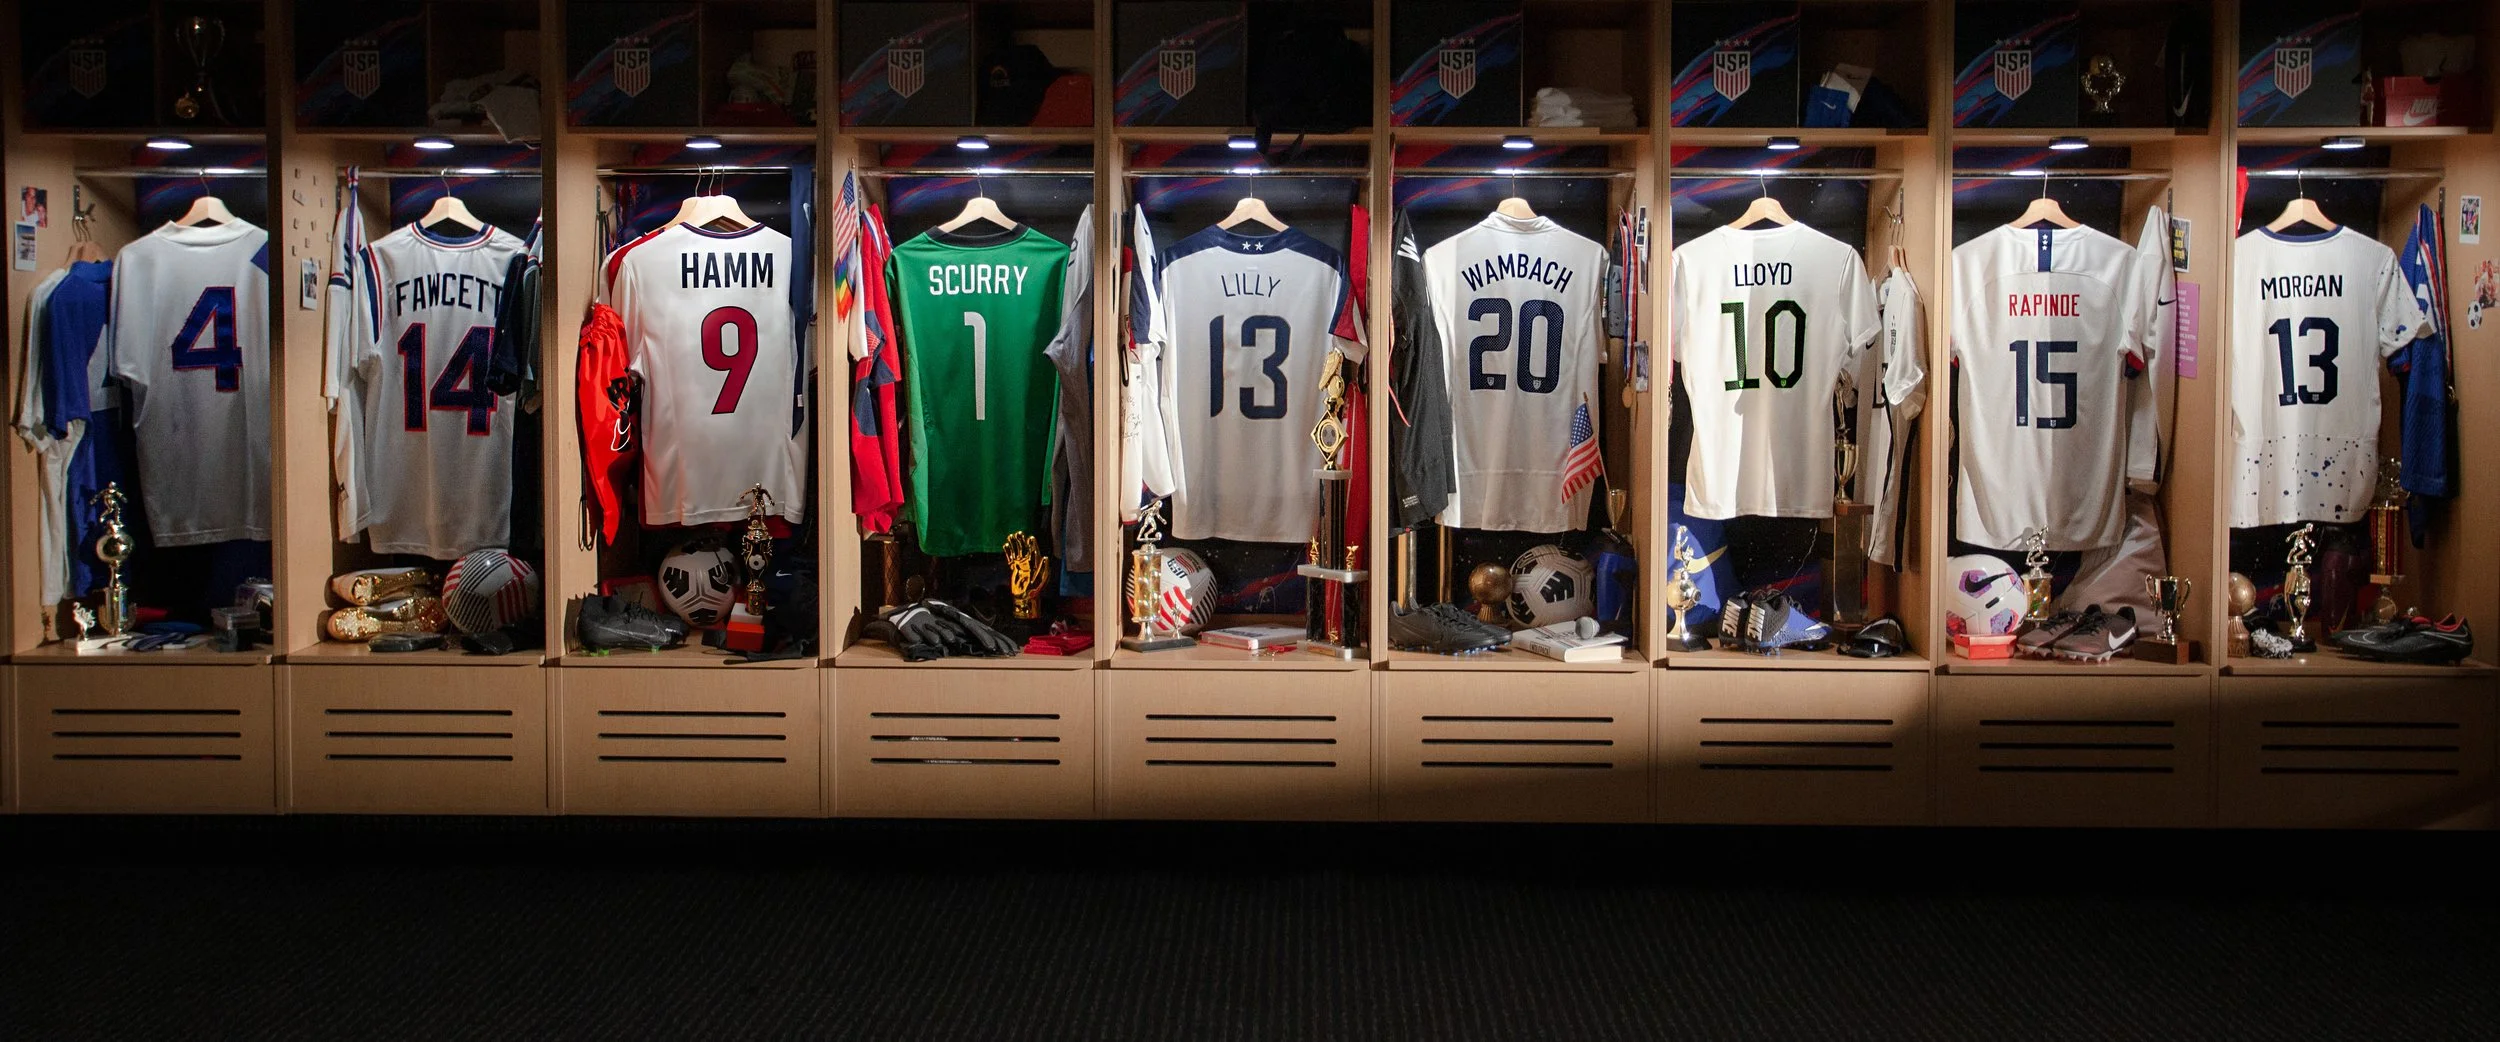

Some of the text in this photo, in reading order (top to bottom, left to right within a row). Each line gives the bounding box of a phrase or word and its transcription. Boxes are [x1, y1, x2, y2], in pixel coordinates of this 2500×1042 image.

[71, 52, 103, 69] USA
[346, 53, 377, 72] USA
[616, 51, 648, 69] USA
[890, 51, 922, 69] USA
[1162, 52, 1193, 70] USA
[1441, 52, 1473, 70] USA
[1716, 54, 1748, 72] USA
[1997, 53, 2029, 71] USA
[2277, 50, 2309, 69] USA
[681, 252, 774, 289] HAMM
[929, 264, 1028, 295] SCURRY
[1221, 273, 1281, 298] LILLY
[1461, 253, 1573, 293] WAMBACH
[1734, 262, 1792, 287] LLOYD
[2261, 275, 2342, 300] MORGAN
[395, 273, 504, 318] FAWCETT
[2009, 294, 2080, 317] RAPINOE
[171, 286, 243, 393] 4
[1468, 297, 1564, 393] 20
[1721, 300, 1806, 391] 10
[701, 306, 758, 415] 9
[964, 311, 986, 420] 1
[1210, 315, 1291, 419] 13
[2269, 317, 2339, 406] 13
[398, 323, 498, 436] 14
[2009, 340, 2077, 429] 15
[1722, 600, 1741, 638] NIKE
[1747, 603, 1765, 641] NIKE
